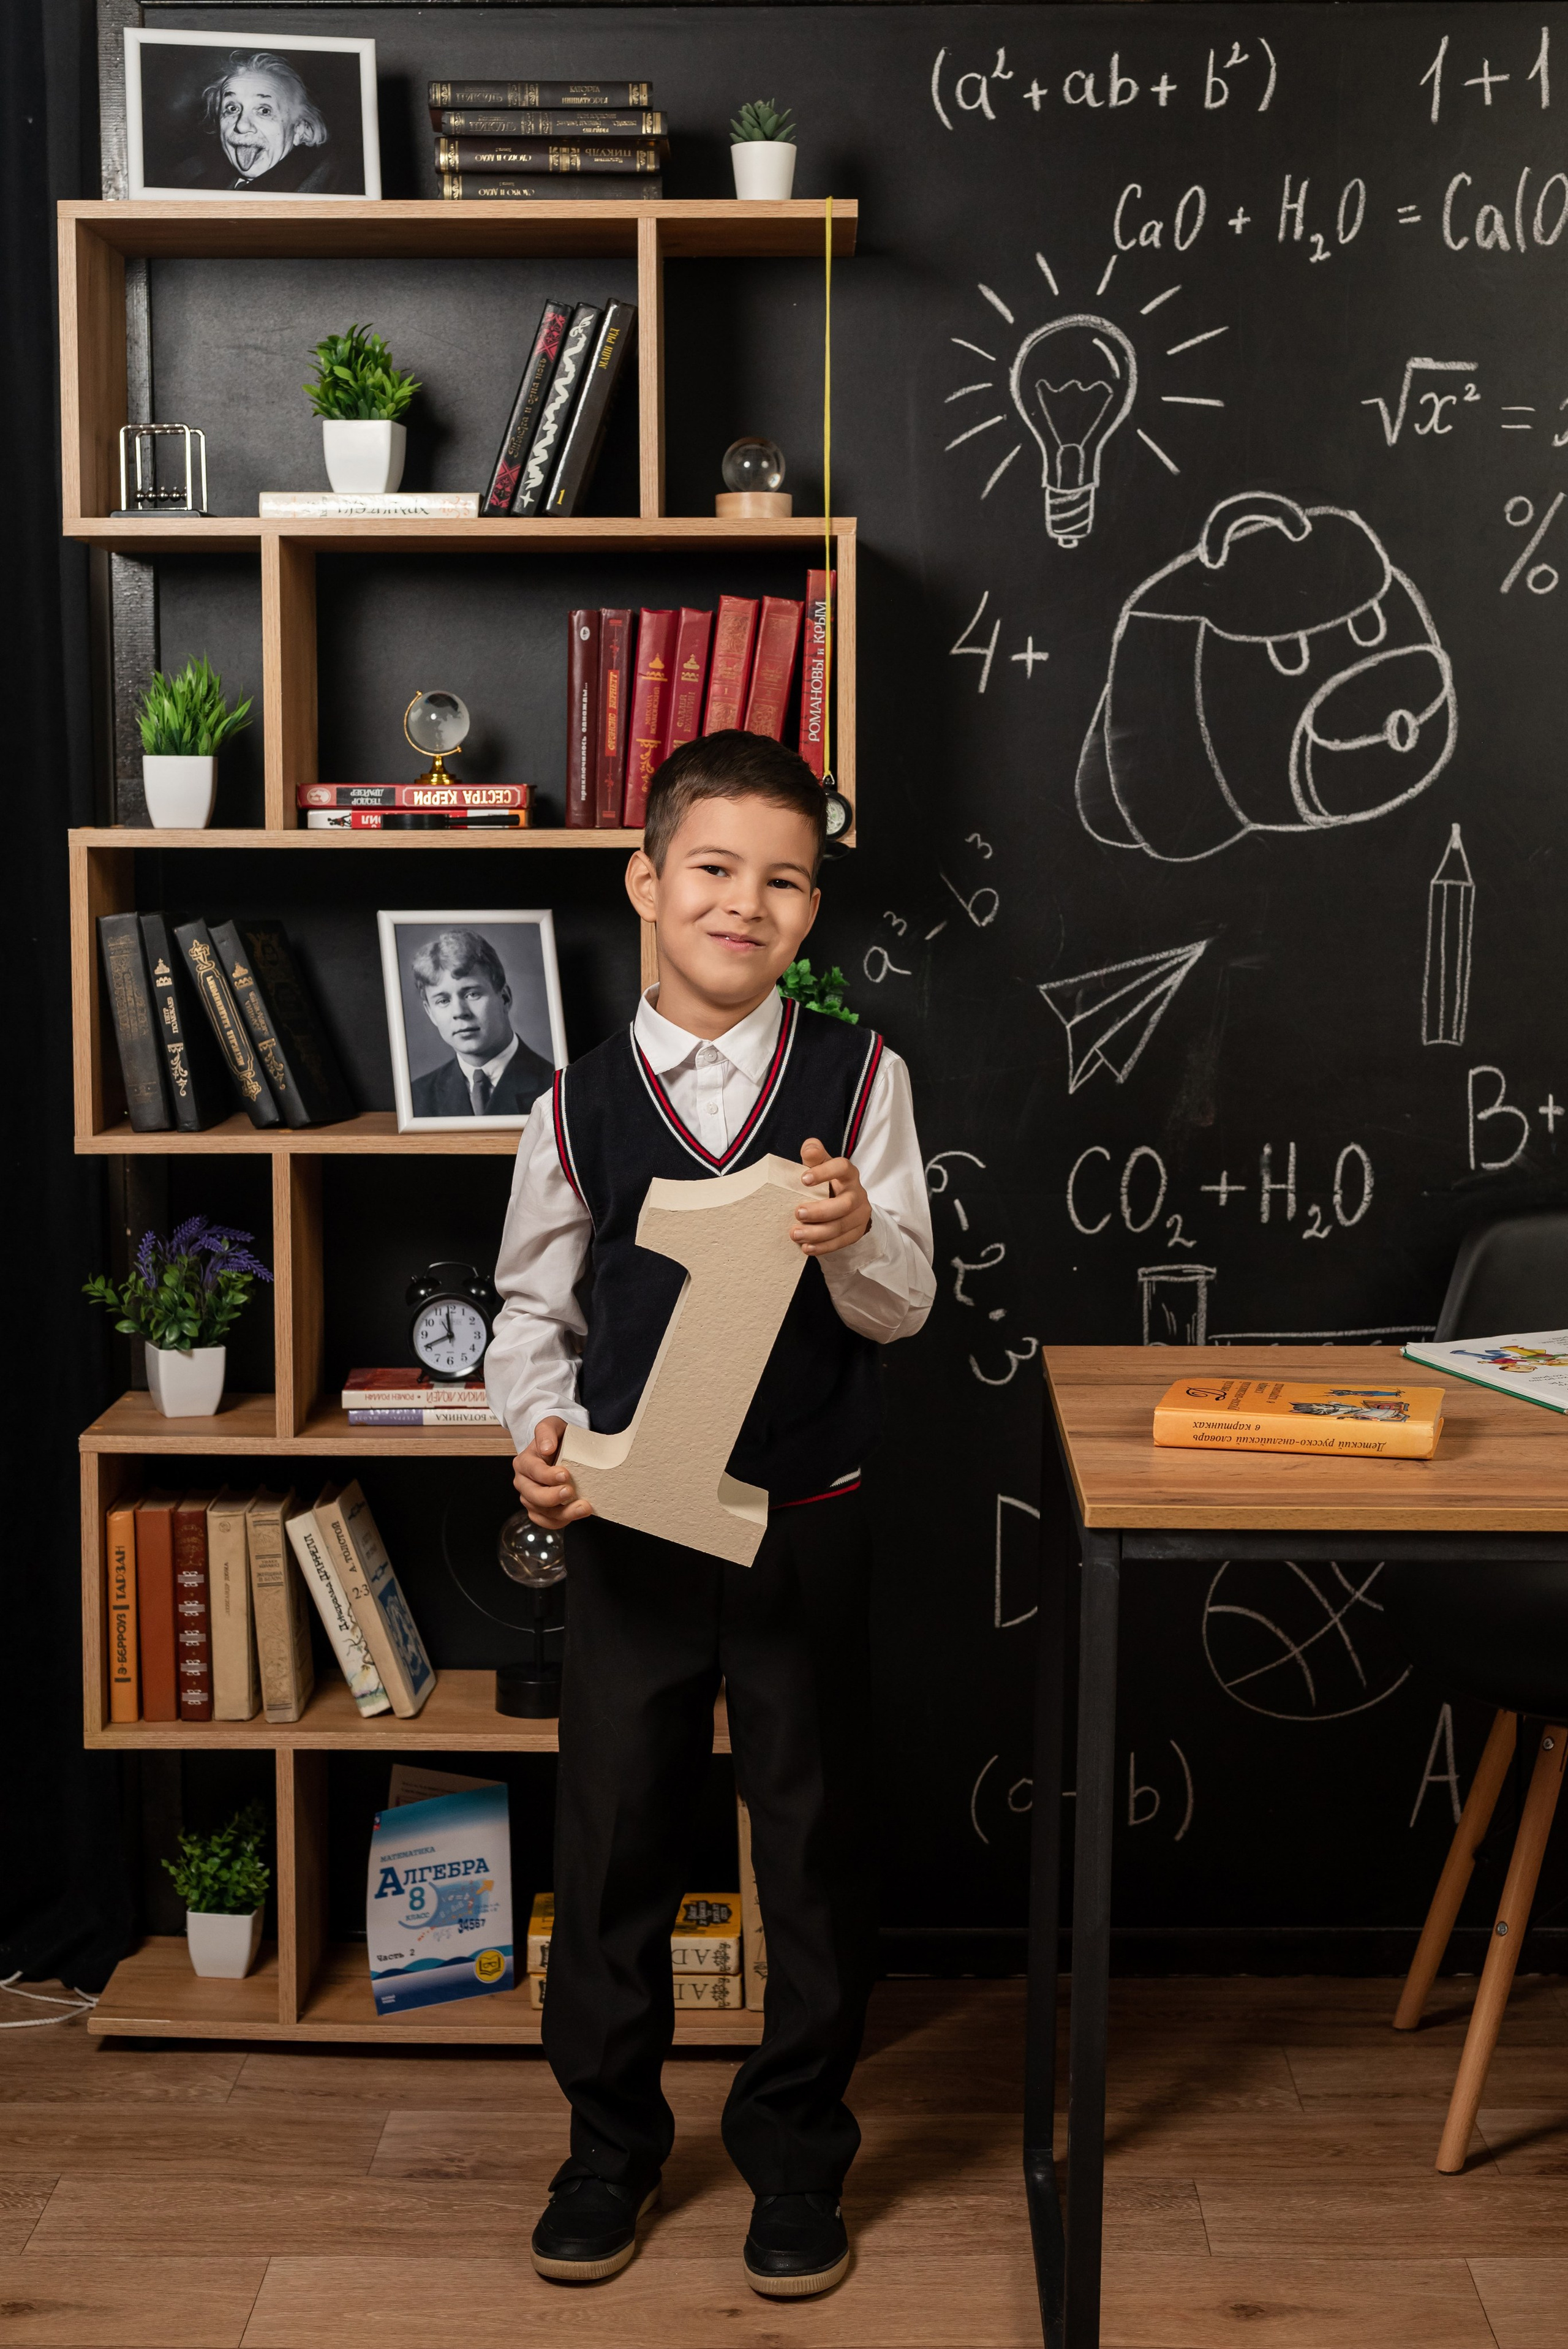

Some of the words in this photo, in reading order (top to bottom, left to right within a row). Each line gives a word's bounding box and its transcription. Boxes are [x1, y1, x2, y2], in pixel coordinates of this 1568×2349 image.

[586, 148, 632, 157] ПИКУЛЬ
[598, 344, 614, 369] МАЙН
[608, 327, 620, 345] РИД
[813, 601, 827, 644] КРЫМ
[609, 671, 618, 709] БЕРНЕТТ
[809, 659, 824, 742] РОМАНОВЫ
[607, 712, 617, 751] ФРЭНСИС
[579, 736, 588, 801] приключилось
[413, 790, 457, 805] КЕРРИ
[465, 789, 511, 804] СЕСТРА
[447, 1305, 457, 1314] 2
[425, 1318, 434, 1327] 10
[469, 1316, 475, 1325] 2
[421, 1330, 428, 1340] 9
[474, 1331, 481, 1340] 3
[469, 1344, 476, 1352] 4
[434, 1354, 441, 1363] 7
[447, 1356, 454, 1366] 6
[461, 1353, 467, 1362] 5
[426, 1390, 458, 1404] ЛЮДЕЙ
[1192, 1420, 1251, 1431] картинках
[1192, 1433, 1232, 1444] словарь
[1235, 1432, 1335, 1449] русско-английский
[1338, 1439, 1386, 1452] Детский
[331, 1520, 355, 1563] ТОЛСТОЙ
[115, 1545, 127, 1601] ТАРЗАН
[380, 1846, 436, 1863] МАТЕМАТИКА
[409, 1886, 425, 1911] 8
[405, 1912, 431, 1922] КЛАСС
[377, 1951, 405, 1962] Часть
[409, 1948, 416, 1956] 2
